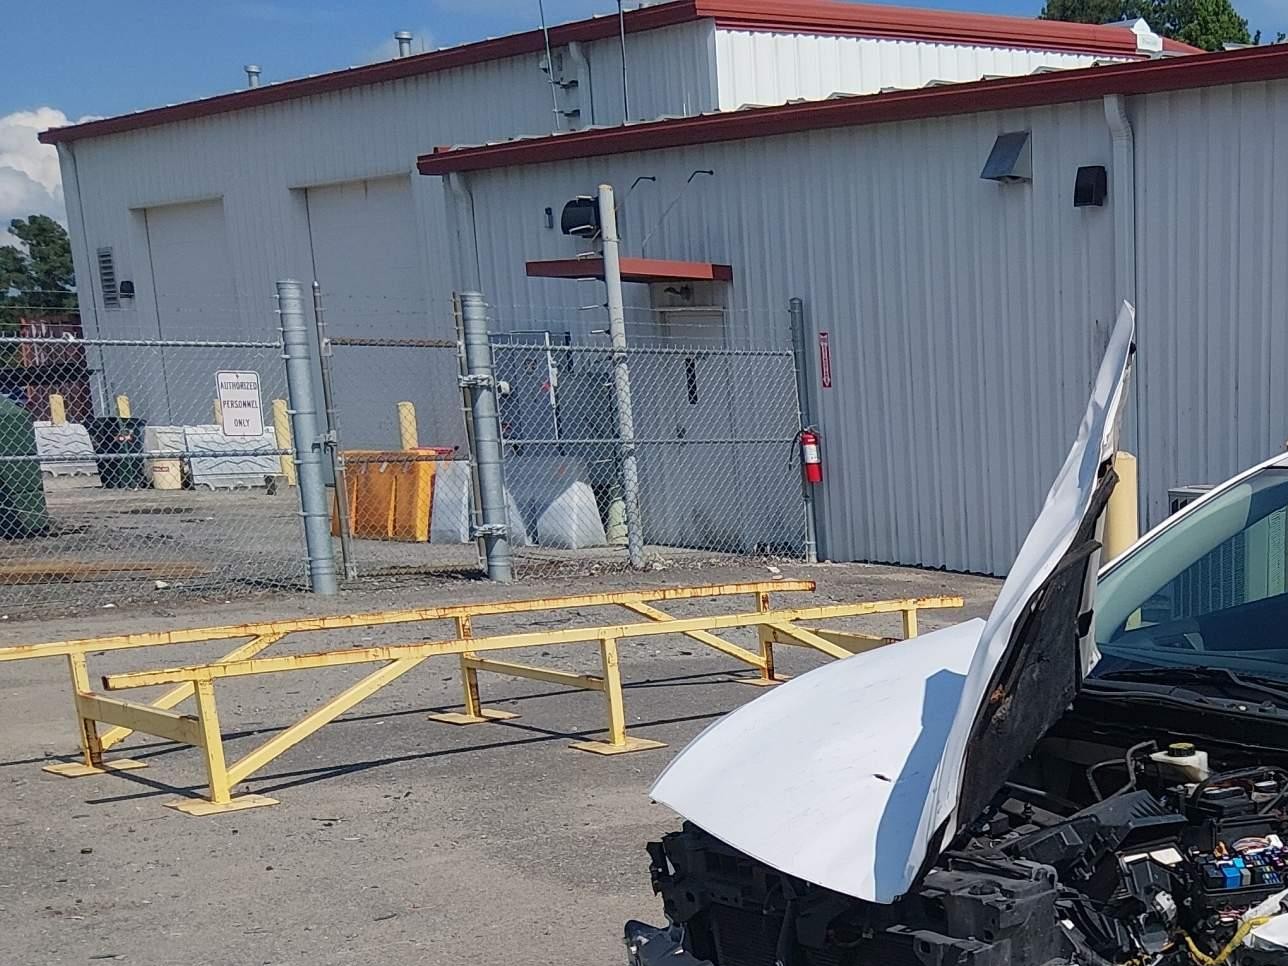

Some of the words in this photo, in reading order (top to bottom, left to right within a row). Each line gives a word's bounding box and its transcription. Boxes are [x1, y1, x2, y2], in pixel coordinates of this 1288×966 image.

[221, 382, 257, 390] AUTHORIZED
[223, 400, 258, 408] PERSONNEL
[234, 419, 250, 427] ONLY
